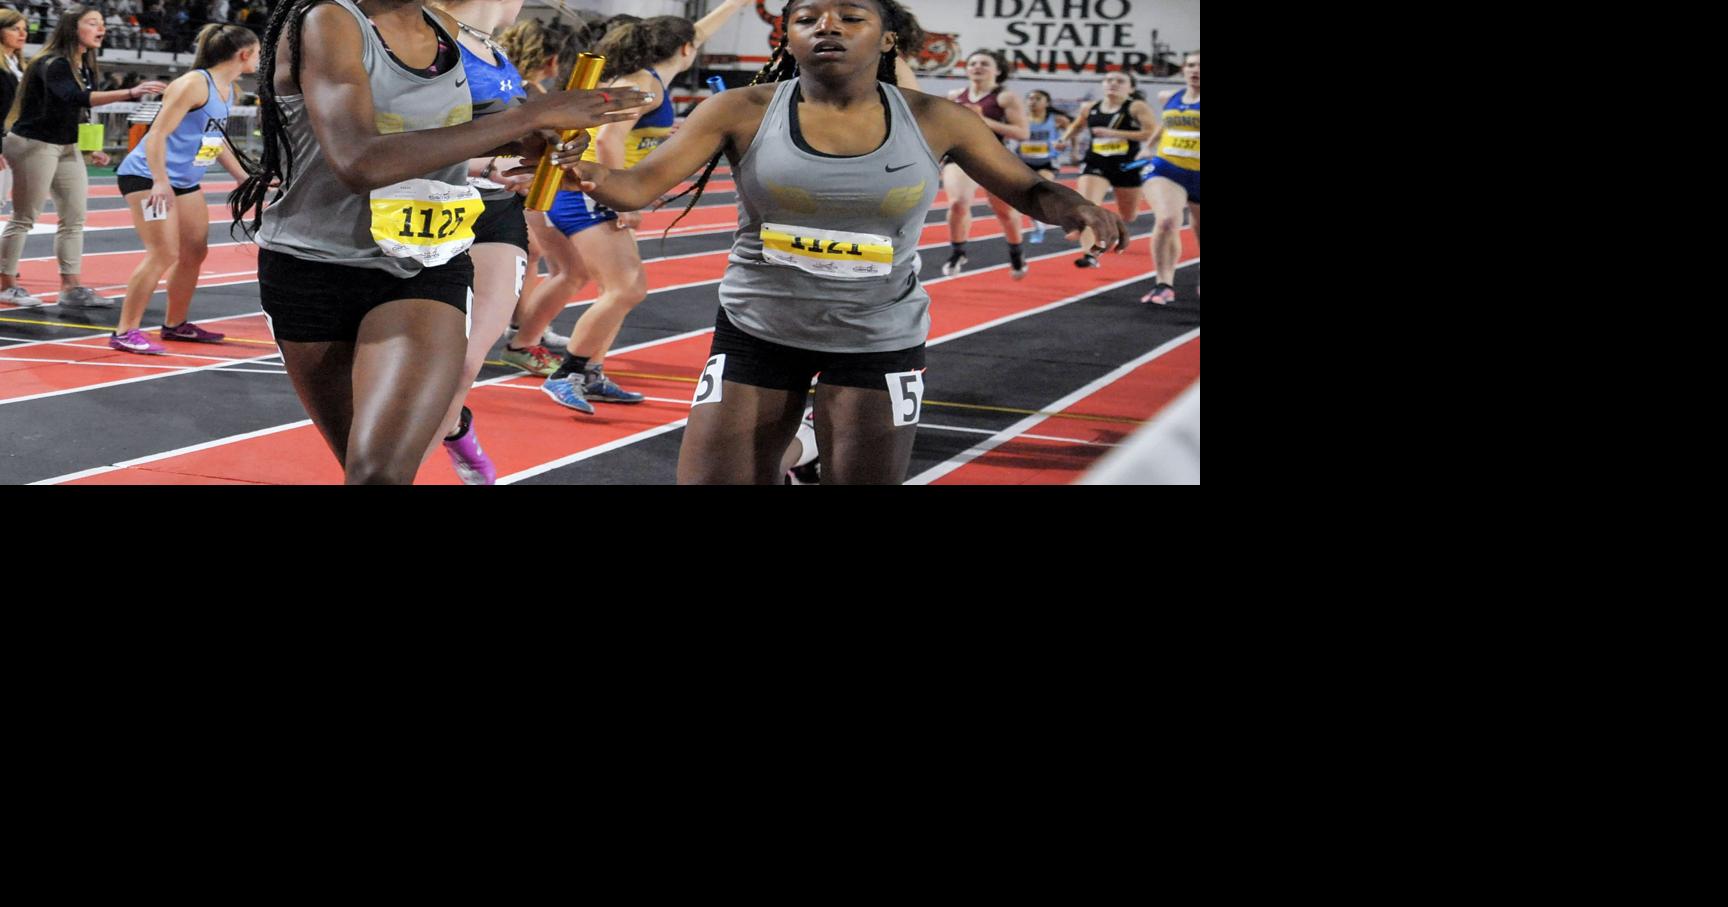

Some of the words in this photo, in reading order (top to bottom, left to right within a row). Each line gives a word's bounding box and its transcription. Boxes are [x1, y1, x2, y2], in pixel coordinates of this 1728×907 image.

[975, 0, 1132, 20] IDAHO
[1004, 21, 1136, 48] STATE
[399, 206, 466, 239] 1125
[696, 358, 717, 402] 5
[898, 375, 918, 422] 5
